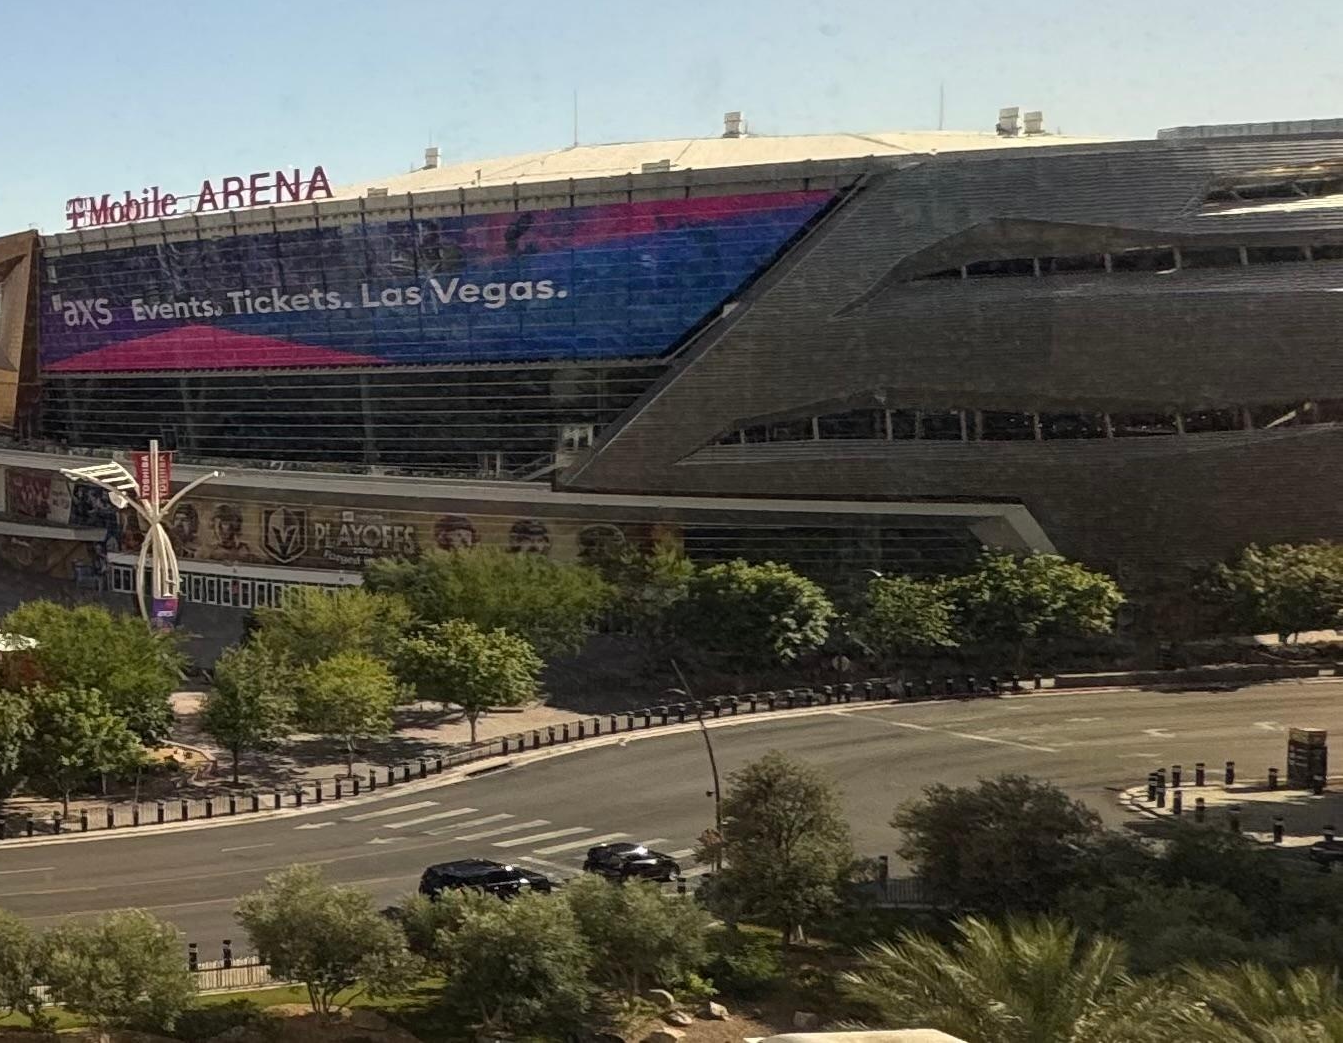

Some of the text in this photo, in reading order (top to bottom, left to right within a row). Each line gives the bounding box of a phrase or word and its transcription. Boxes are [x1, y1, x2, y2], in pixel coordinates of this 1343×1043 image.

[196, 165, 334, 213] ARENA
[131, 297, 220, 322] Events.
[226, 288, 353, 315] Tickets.
[362, 282, 422, 308] Las
[430, 276, 568, 309] Vegas.
[141, 455, 151, 497] TOSHIBA
[314, 521, 415, 556] PLAYOFFS
